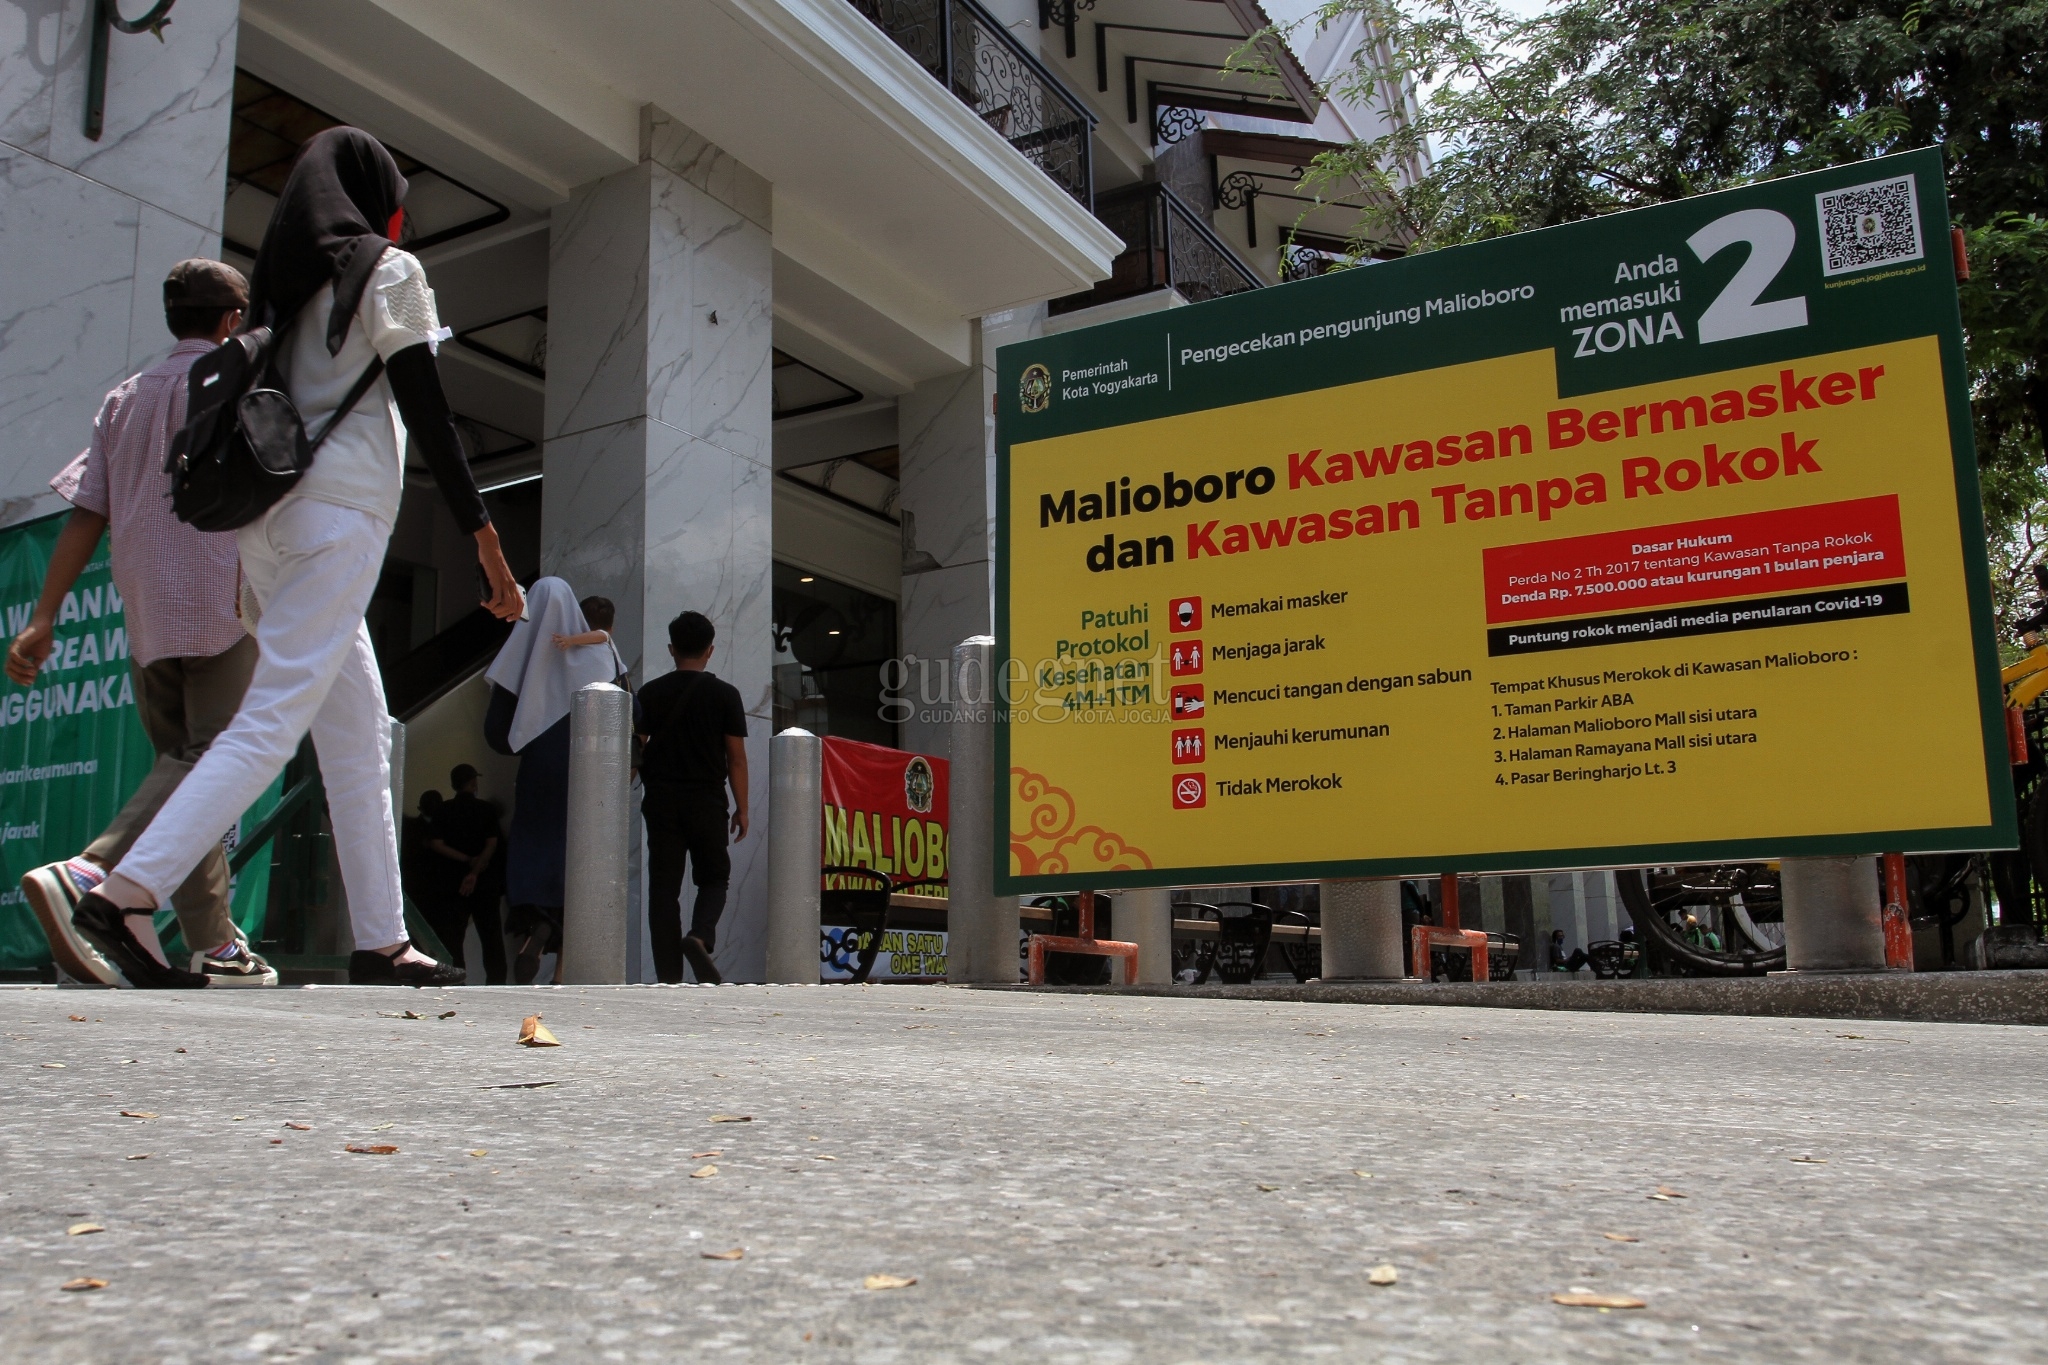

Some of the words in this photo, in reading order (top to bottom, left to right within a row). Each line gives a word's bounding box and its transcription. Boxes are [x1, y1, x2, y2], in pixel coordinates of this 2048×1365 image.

[1572, 311, 1683, 359] ZONA
[1685, 208, 1808, 344] 2
[1614, 253, 1679, 284] Anda
[1824, 264, 1926, 289] kunjungan.jogjakota.go.id
[1560, 280, 1682, 323] memasuki
[1181, 328, 1296, 366] Pengecekan
[1299, 302, 1421, 346] pengunjung
[1425, 282, 1535, 318] Malioboro
[1062, 358, 1129, 383] Pemerintah
[1062, 384, 1090, 401] Kota
[1092, 371, 1159, 398] Yogyakarta
[1039, 466, 1276, 528] Malioboro
[1287, 420, 1532, 490] Kawasan
[1546, 364, 1885, 450] Bermasker
[1086, 533, 1174, 573] dan
[1187, 497, 1420, 560] Kawasan
[1431, 470, 1607, 524] Tanpa
[1621, 431, 1823, 499] Rokok
[1631, 541, 1674, 555] Dasar
[1677, 532, 1733, 550] Hukum
[1508, 571, 1548, 587] Perda
[1550, 569, 1571, 582] No
[1573, 567, 1583, 579] 2
[1585, 563, 1603, 577] Th
[1605, 559, 1640, 576] 2017
[1643, 552, 1700, 571] tentang
[1703, 544, 1770, 563] Kawasan
[1772, 538, 1820, 557] Tanpa
[1824, 531, 1873, 549] Rokok
[1501, 589, 1547, 606] Denda
[1549, 586, 1573, 604] Rp.
[1574, 577, 1648, 597] 7.500.000
[1650, 573, 1685, 589] atau
[1686, 564, 1762, 586] kurungan
[1763, 563, 1771, 575] 1
[1773, 556, 1819, 574] bulan
[1822, 550, 1885, 571] penjara
[1081, 602, 1149, 630] Patuhi
[1211, 595, 1284, 619] Memakai
[1286, 590, 1348, 610] masker
[1508, 627, 1570, 647] Puntung
[1572, 622, 1615, 640] rokok
[1617, 614, 1678, 635] menjadi
[1681, 609, 1729, 627] media
[1731, 601, 1812, 624] penularan
[1814, 593, 1883, 613] Covid-19
[1056, 629, 1149, 659] Protokol
[1211, 639, 1281, 662] Menjaga
[1282, 634, 1326, 654] jarak
[1039, 660, 1149, 688] Kesehatan
[1213, 684, 1281, 705] Mencuci
[1283, 678, 1343, 700] tangan
[1346, 672, 1414, 694] dengan
[1416, 667, 1472, 686] sabun
[1490, 677, 1545, 696] Tempat
[1547, 672, 1601, 690] Khusus
[1603, 664, 1672, 684] Merokok
[1674, 662, 1689, 677] di
[1692, 656, 1762, 675] Kawasan
[1764, 649, 1850, 668] Malioboro
[1061, 684, 1150, 712] 4M+1TM
[1491, 704, 1502, 717] 1.
[1504, 700, 1552, 716] Taman
[1554, 696, 1599, 713] Parkir
[1600, 692, 1634, 708] ABA
[1214, 728, 1289, 751] Menjauhi
[1291, 723, 1390, 745] kerumunan
[1492, 727, 1506, 741] 2.
[1508, 722, 1571, 739] Halaman
[1573, 714, 1652, 735] Malioboro
[1654, 710, 1686, 727] Mall
[1688, 708, 1713, 724] sisi
[1715, 705, 1758, 721] utara
[1494, 749, 1507, 763] 3.
[1509, 745, 1572, 762] Halaman
[1575, 738, 1652, 758] Ramayana
[1654, 734, 1686, 751] Mall
[1688, 732, 1713, 748] sisi
[1715, 730, 1758, 746] utara
[1216, 778, 1263, 796] Tidak
[1265, 772, 1343, 794] Merokok
[1495, 773, 1509, 786] 4.
[1510, 769, 1551, 786] Pasar
[1553, 762, 1642, 783] Beringharjo
[1644, 761, 1665, 776] Lt.
[1666, 760, 1677, 774] 3
[1, 821, 40, 845] jarak
[824, 803, 949, 879] MALIOB
[907, 932, 944, 955] SATU
[891, 953, 922, 975] ONE
